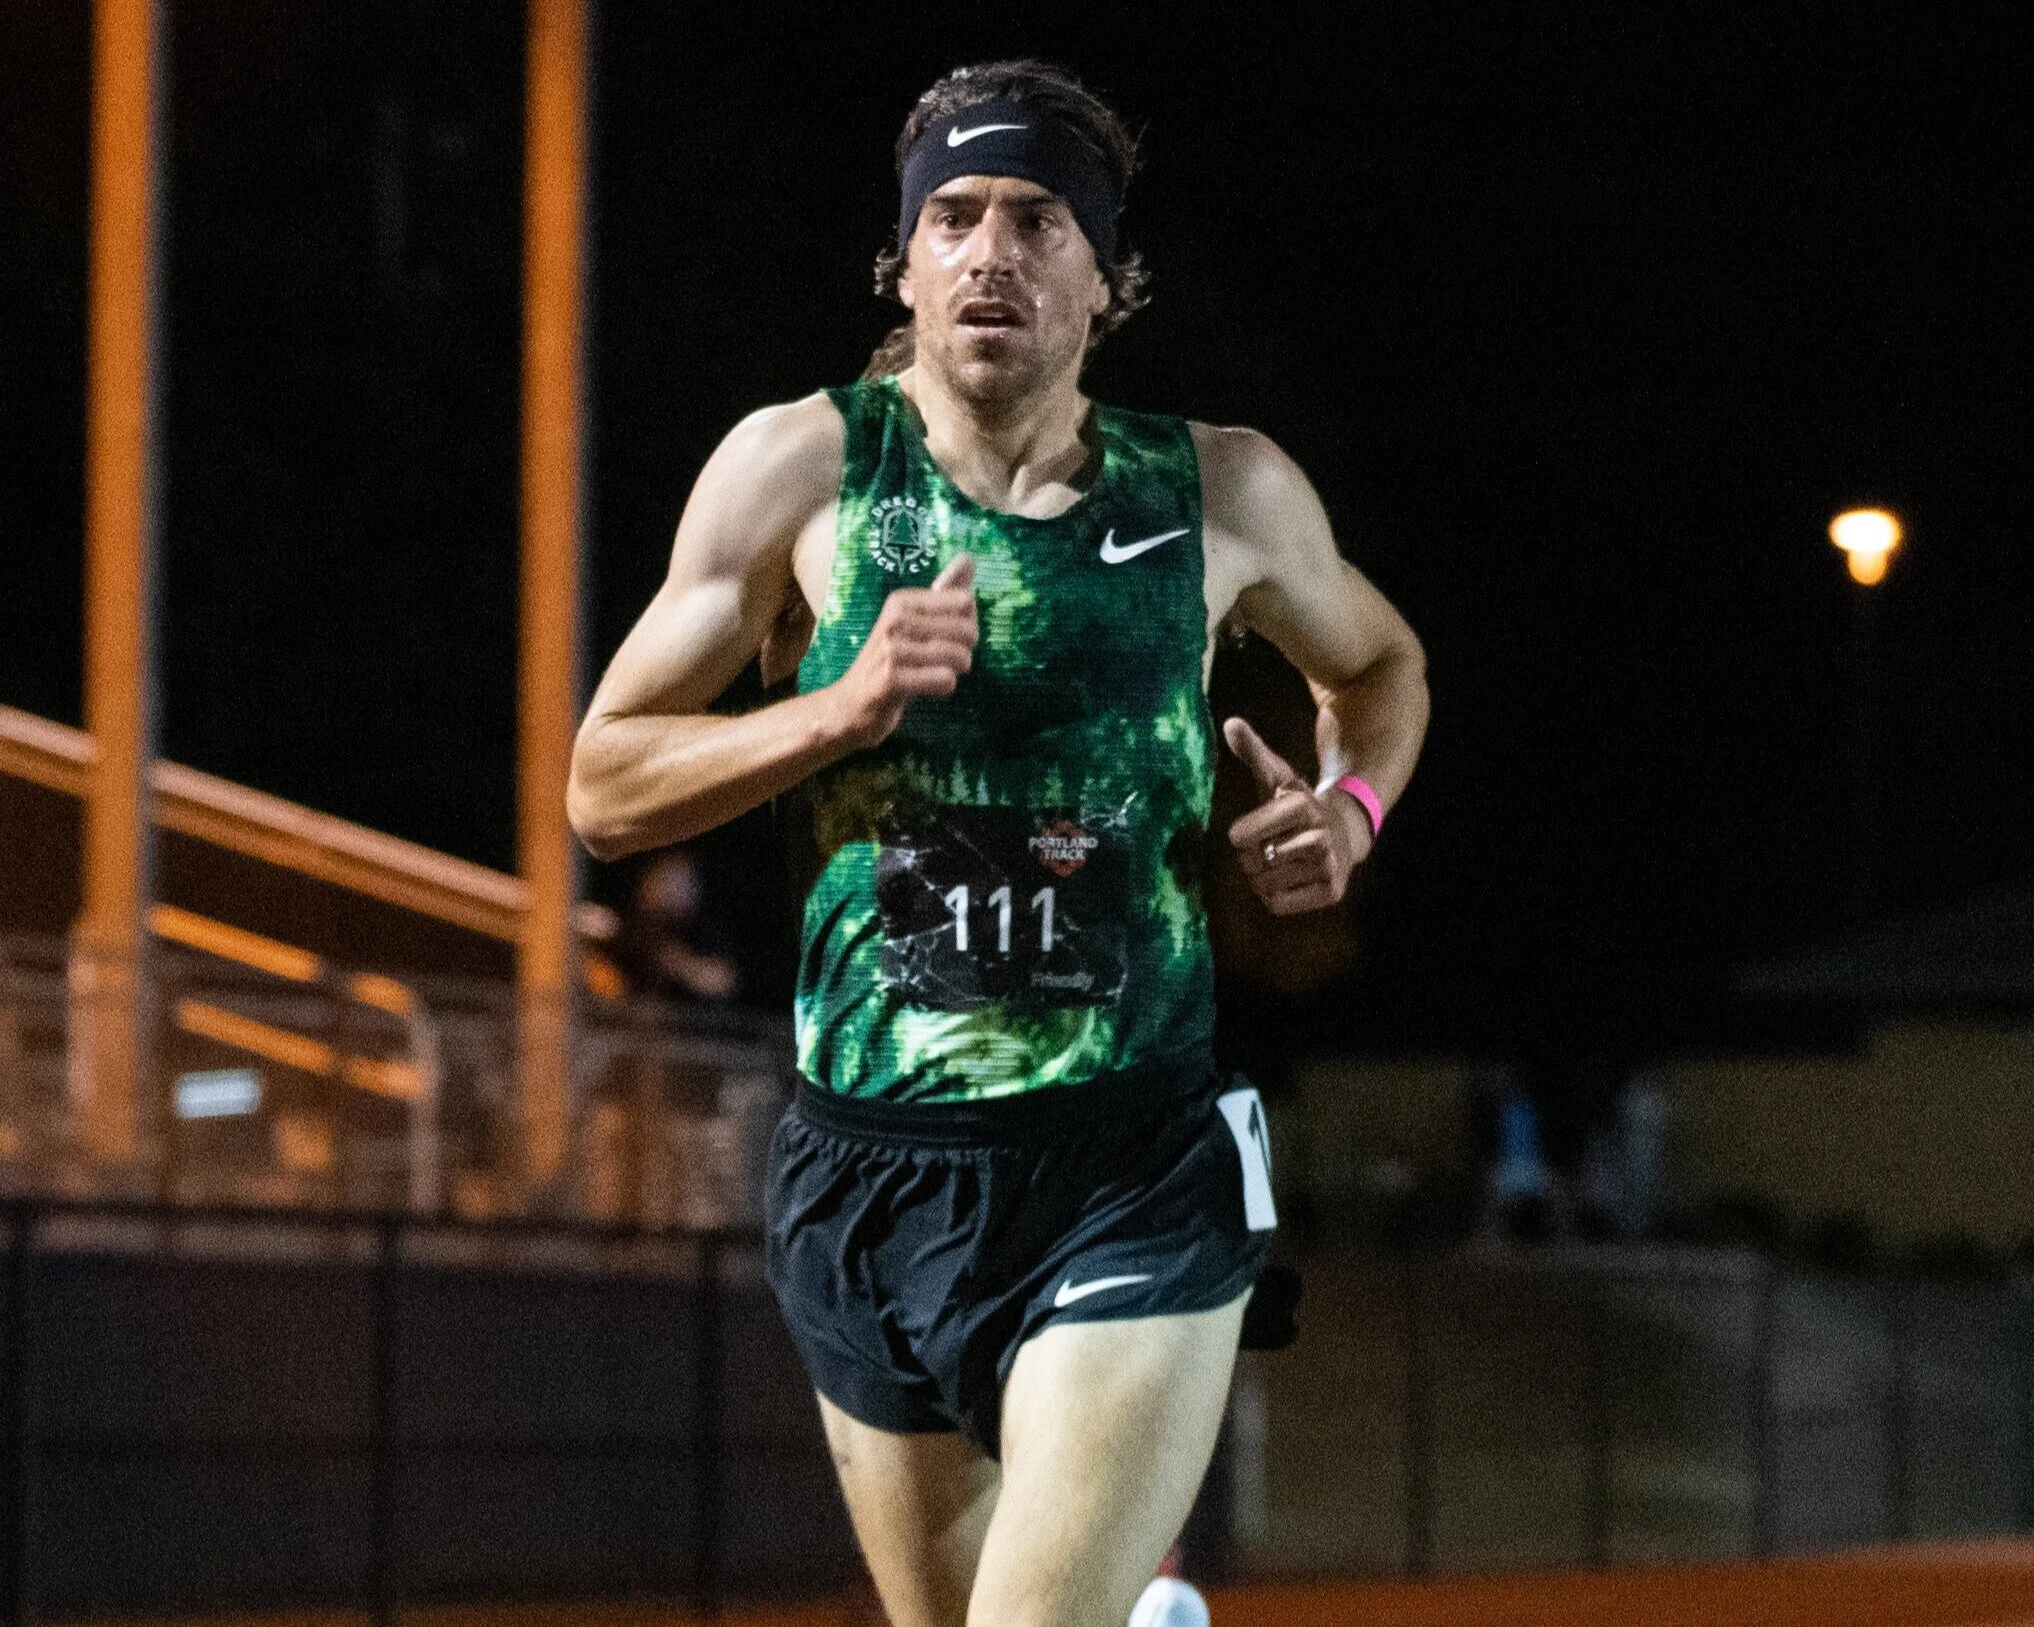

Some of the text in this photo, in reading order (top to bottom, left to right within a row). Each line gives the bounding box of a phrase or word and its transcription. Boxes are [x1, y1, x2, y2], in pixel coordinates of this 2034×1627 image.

[1028, 837, 1099, 850] PORTLAND
[1044, 849, 1086, 860] TRACK
[944, 885, 1056, 952] 111
